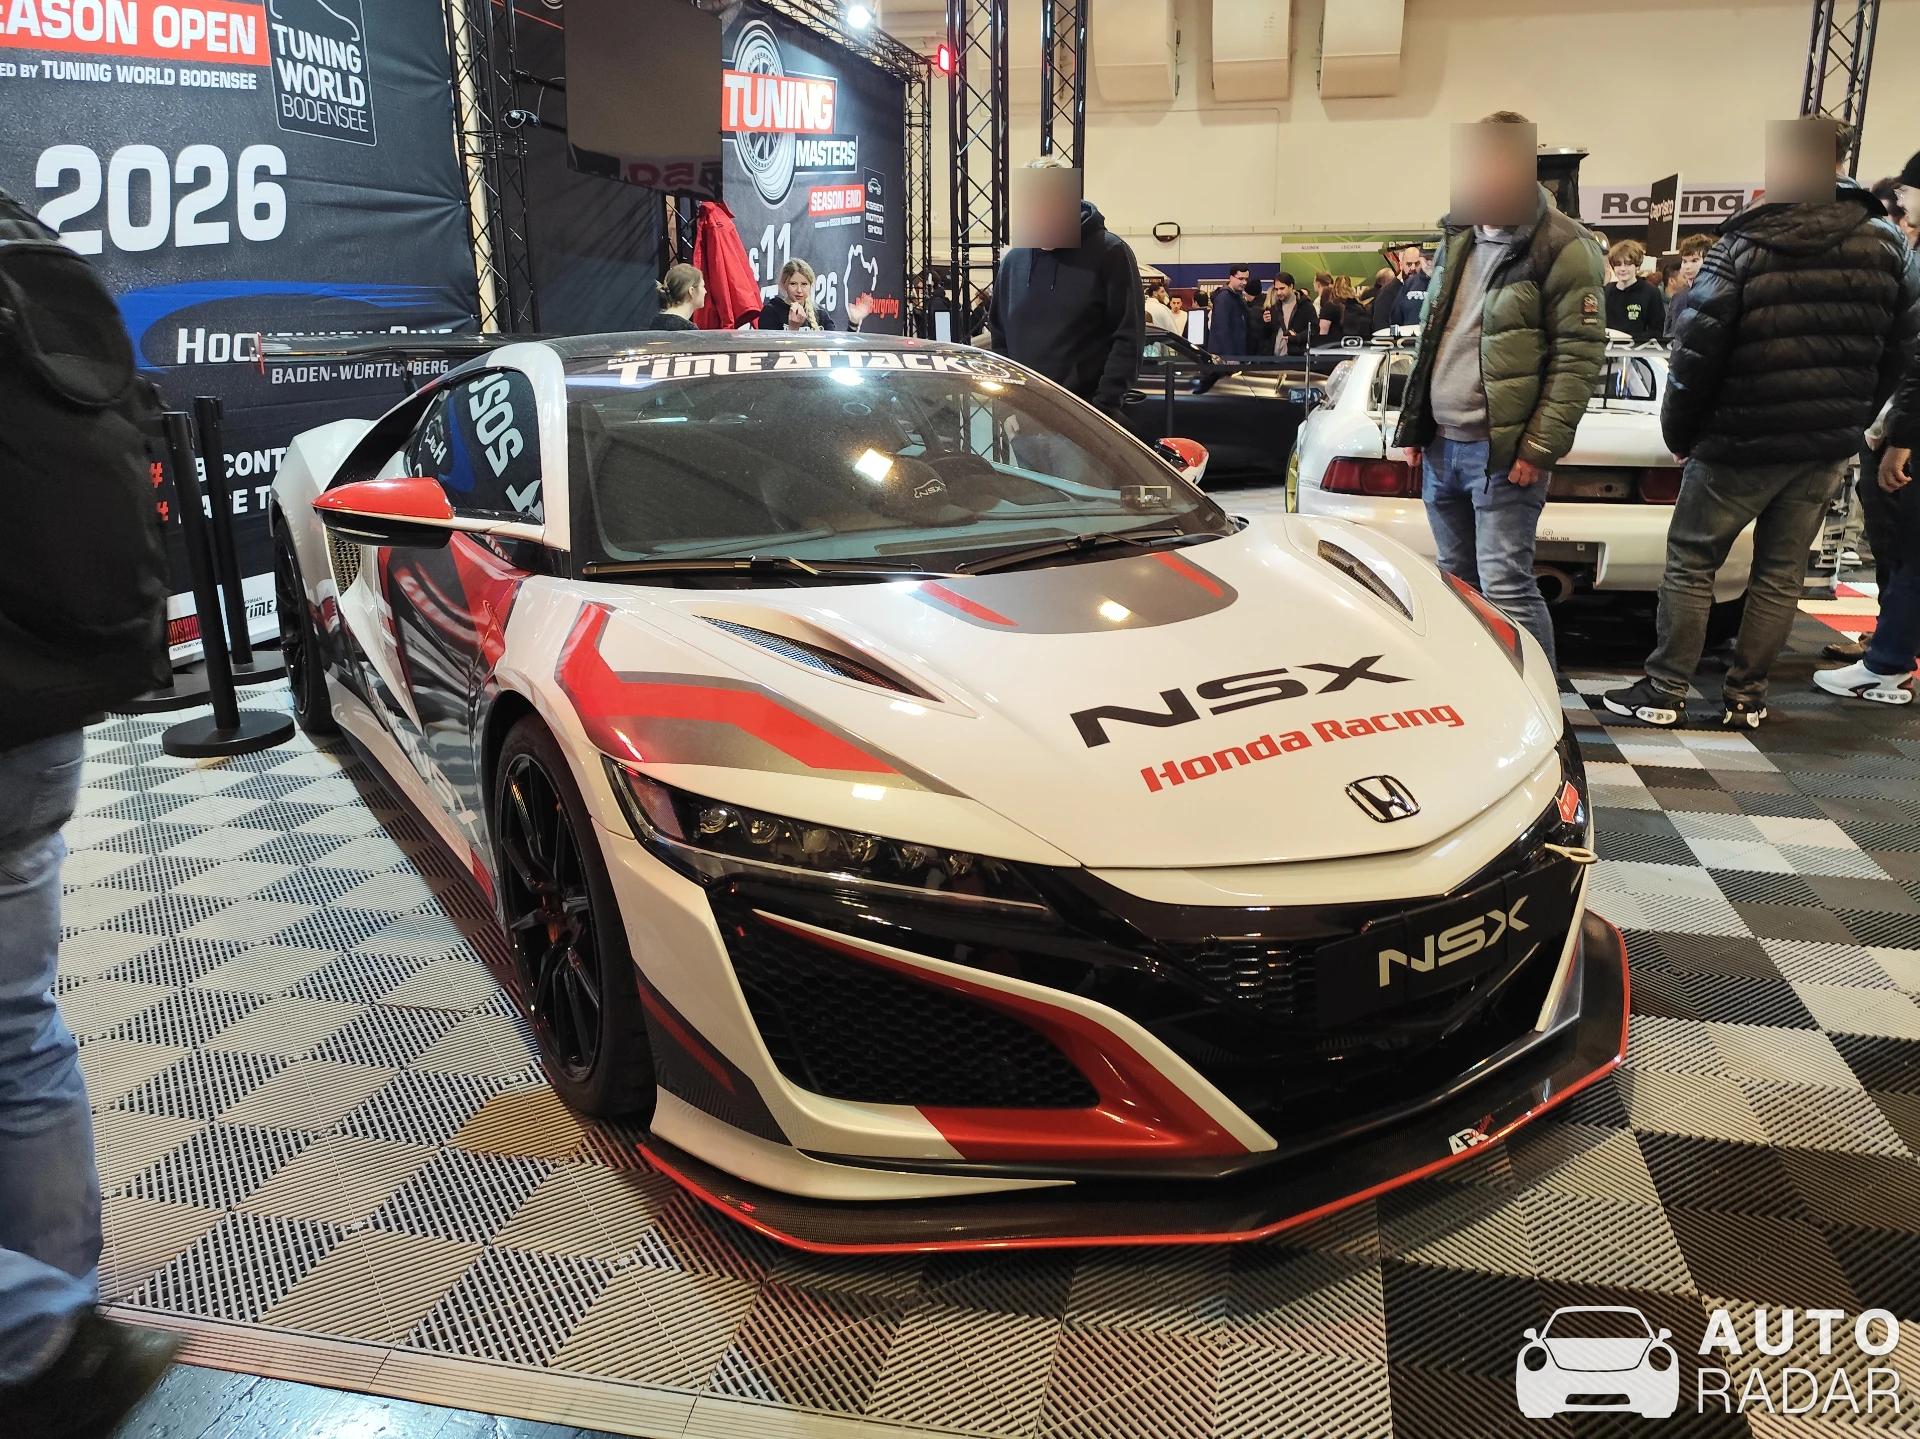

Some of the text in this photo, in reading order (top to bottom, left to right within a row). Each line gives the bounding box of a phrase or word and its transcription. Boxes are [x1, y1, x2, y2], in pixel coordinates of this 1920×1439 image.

[0, 0, 257, 55] ASON OPEN
[272, 23, 362, 75] TUNING
[20, 64, 39, 79] BY
[41, 60, 112, 83] TUNING
[116, 64, 175, 86] WORLD
[180, 72, 258, 90] BODENSEE
[276, 57, 367, 108] WORLD
[280, 93, 369, 134] BODENSEE
[724, 74, 833, 130] TUNING
[796, 140, 856, 167] MASTERS
[35, 144, 288, 256] 2026
[811, 189, 862, 211] SEASON END
[866, 200, 884, 212] ESSEN
[866, 212, 884, 224] MOTOR
[867, 225, 882, 235] SHOW
[773, 350, 975, 373] ATTACK
[919, 485, 944, 498] NSX
[1070, 654, 1415, 749] NSX
[1140, 704, 1466, 793] Honda Racing
[1378, 895, 1530, 988] NSX
